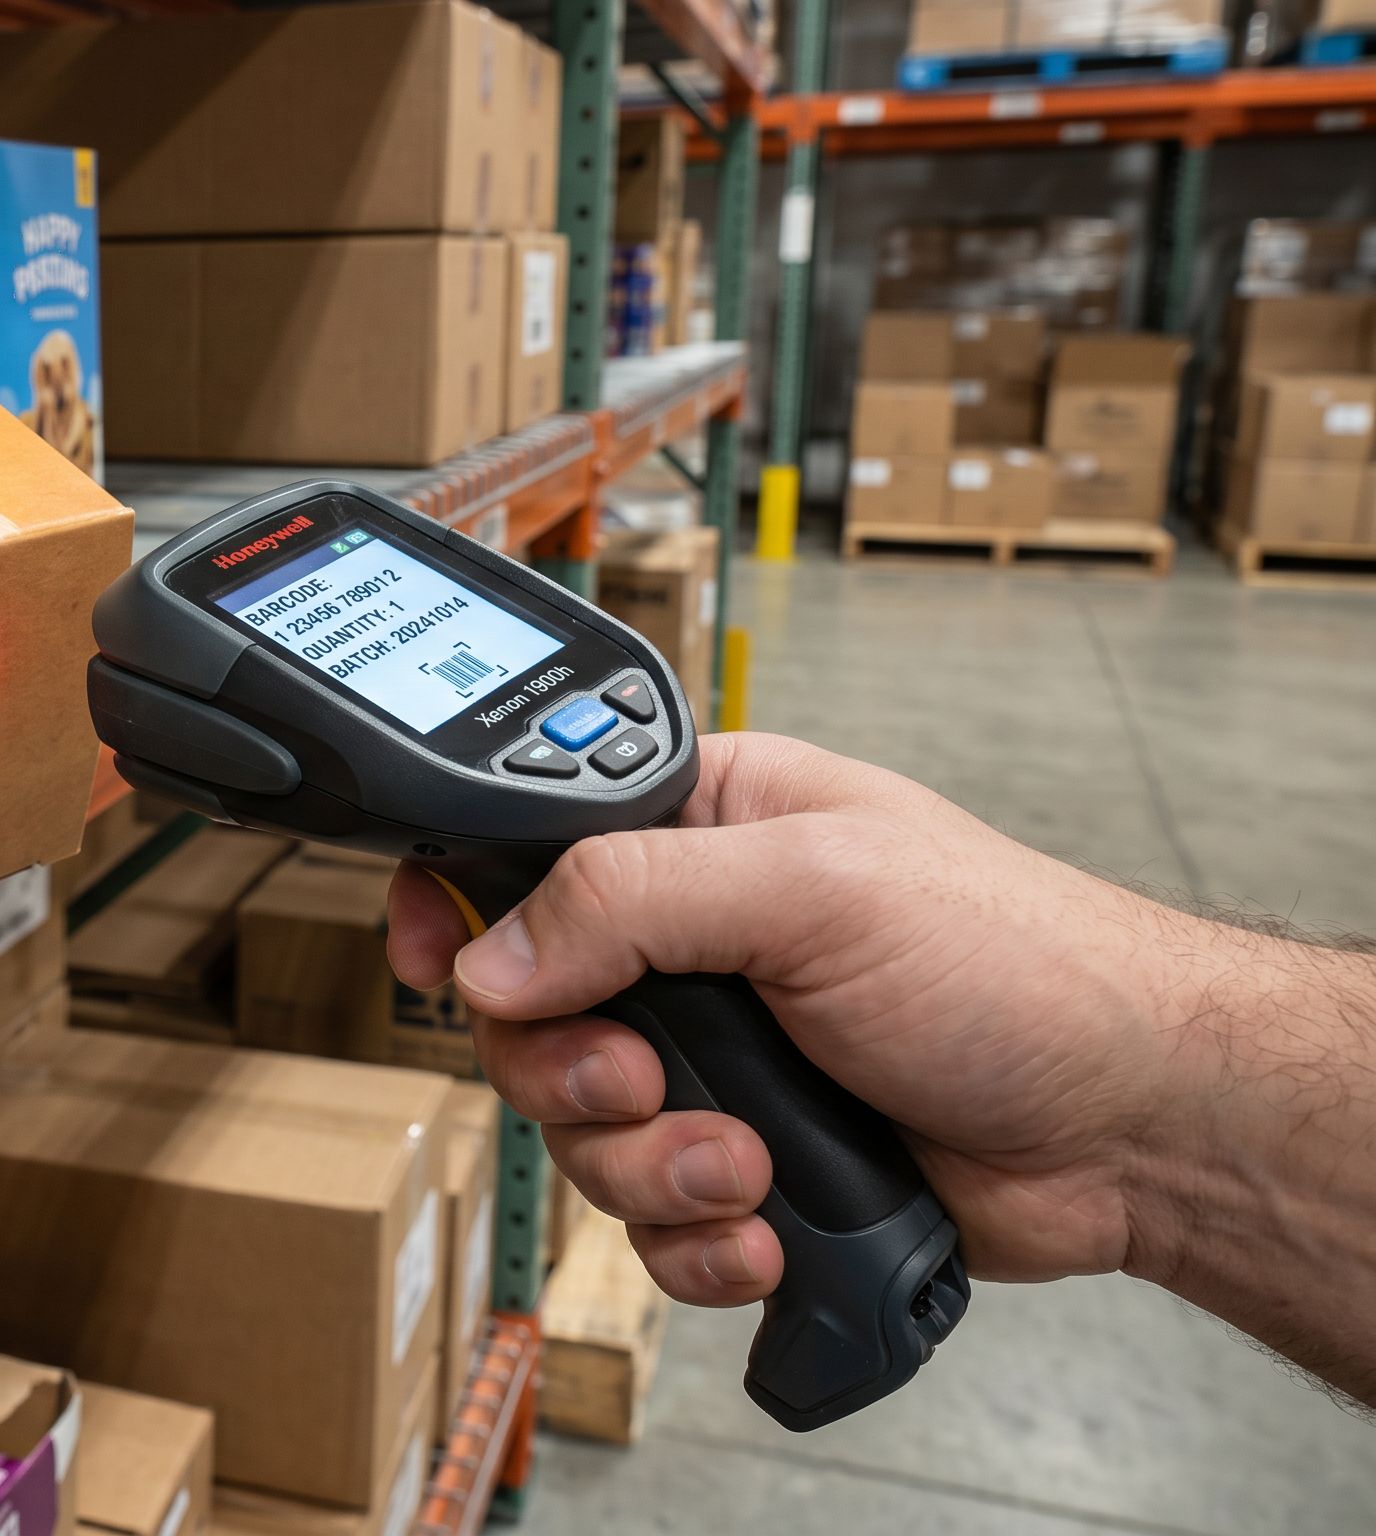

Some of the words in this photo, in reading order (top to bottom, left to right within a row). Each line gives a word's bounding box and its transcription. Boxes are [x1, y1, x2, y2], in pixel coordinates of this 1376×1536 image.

[211, 515, 314, 570] Honeywell
[245, 578, 333, 626] BARCODE:
[274, 631, 290, 643] 1
[287, 602, 341, 636] 23456
[301, 609, 394, 661] QUANTITY:
[389, 600, 405, 612] 1
[328, 640, 396, 679] BATCH:
[390, 596, 469, 645] 20241014
[474, 694, 530, 728] Xenon
[524, 666, 575, 696] 1900h
